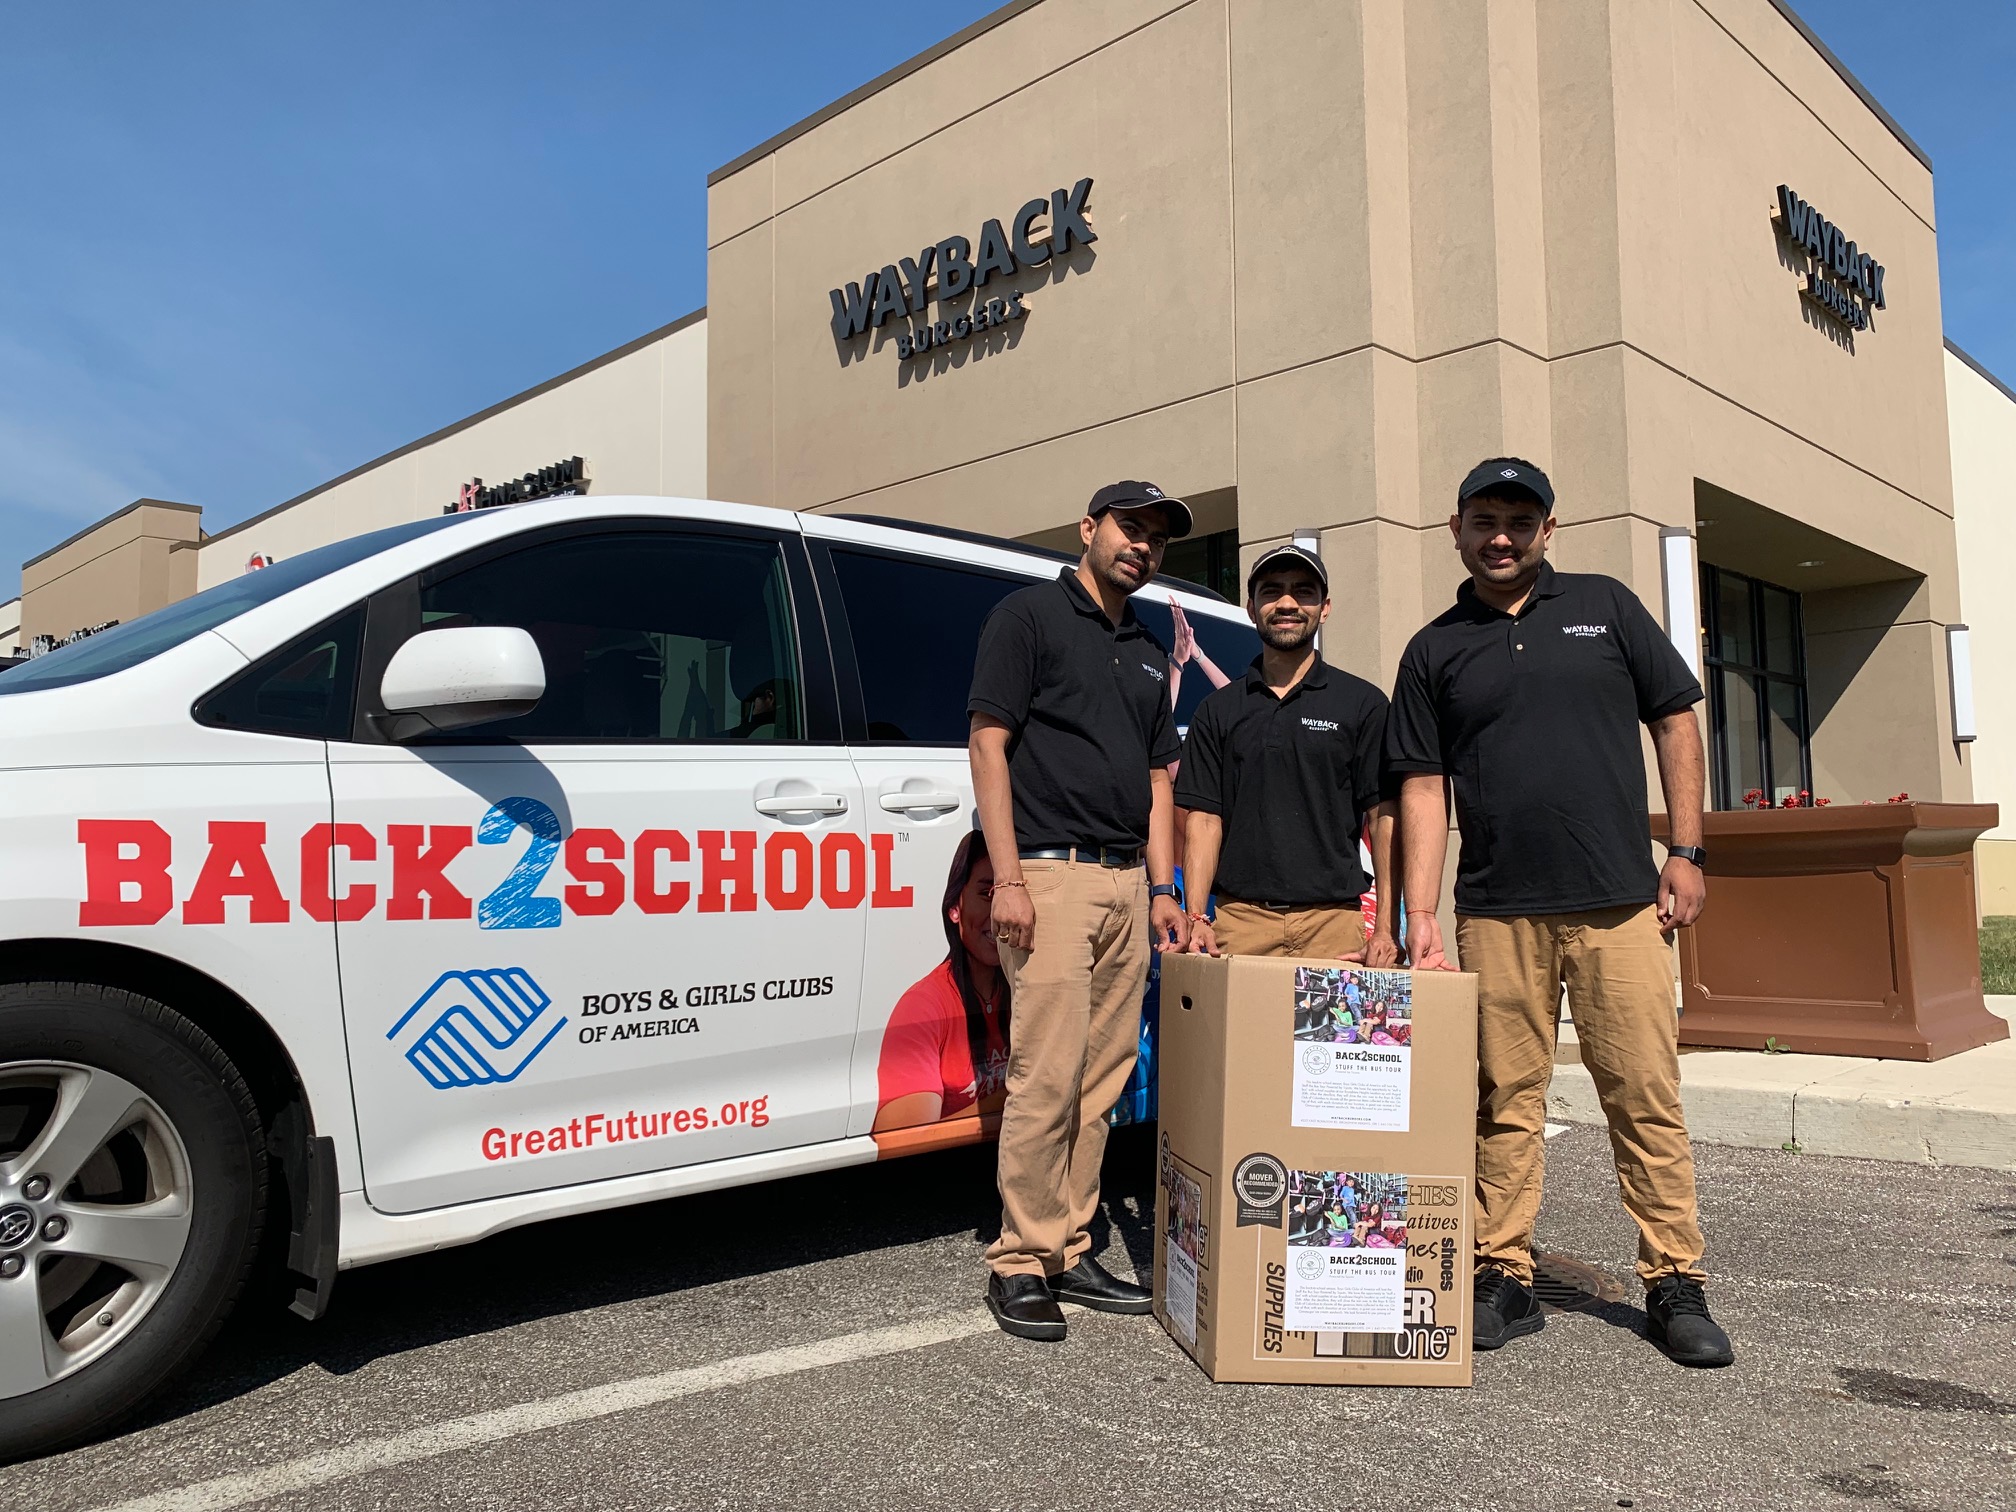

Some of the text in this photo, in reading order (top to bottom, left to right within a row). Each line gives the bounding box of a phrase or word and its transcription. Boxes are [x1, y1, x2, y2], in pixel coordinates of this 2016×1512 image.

[829, 177, 1098, 340] WAYBACK
[1776, 184, 1886, 310] WAYBACK
[1807, 272, 1869, 331] BURGERS
[898, 291, 1024, 360] BURGERS
[1562, 624, 1607, 634] WAYBACK
[1301, 717, 1339, 730] WAYBACK
[78, 796, 914, 930] BACK2SCHOOL
[580, 976, 834, 1017] BOYS & GIRLS CLUBS
[578, 1017, 700, 1044] OF AMERICA
[1335, 1050, 1402, 1063] BACK2SCHOOL
[481, 1095, 770, 1161] GreatFutures.org
[1243, 1180, 1279, 1188] RECOMMENDED
[1248, 1173, 1273, 1181] MOVER
[1329, 1254, 1397, 1266] BACK2SCHOOL
[1440, 1237, 1457, 1292] shoes
[1263, 1262, 1286, 1353] SUPPLIES
[1394, 1328, 1448, 1358] one
